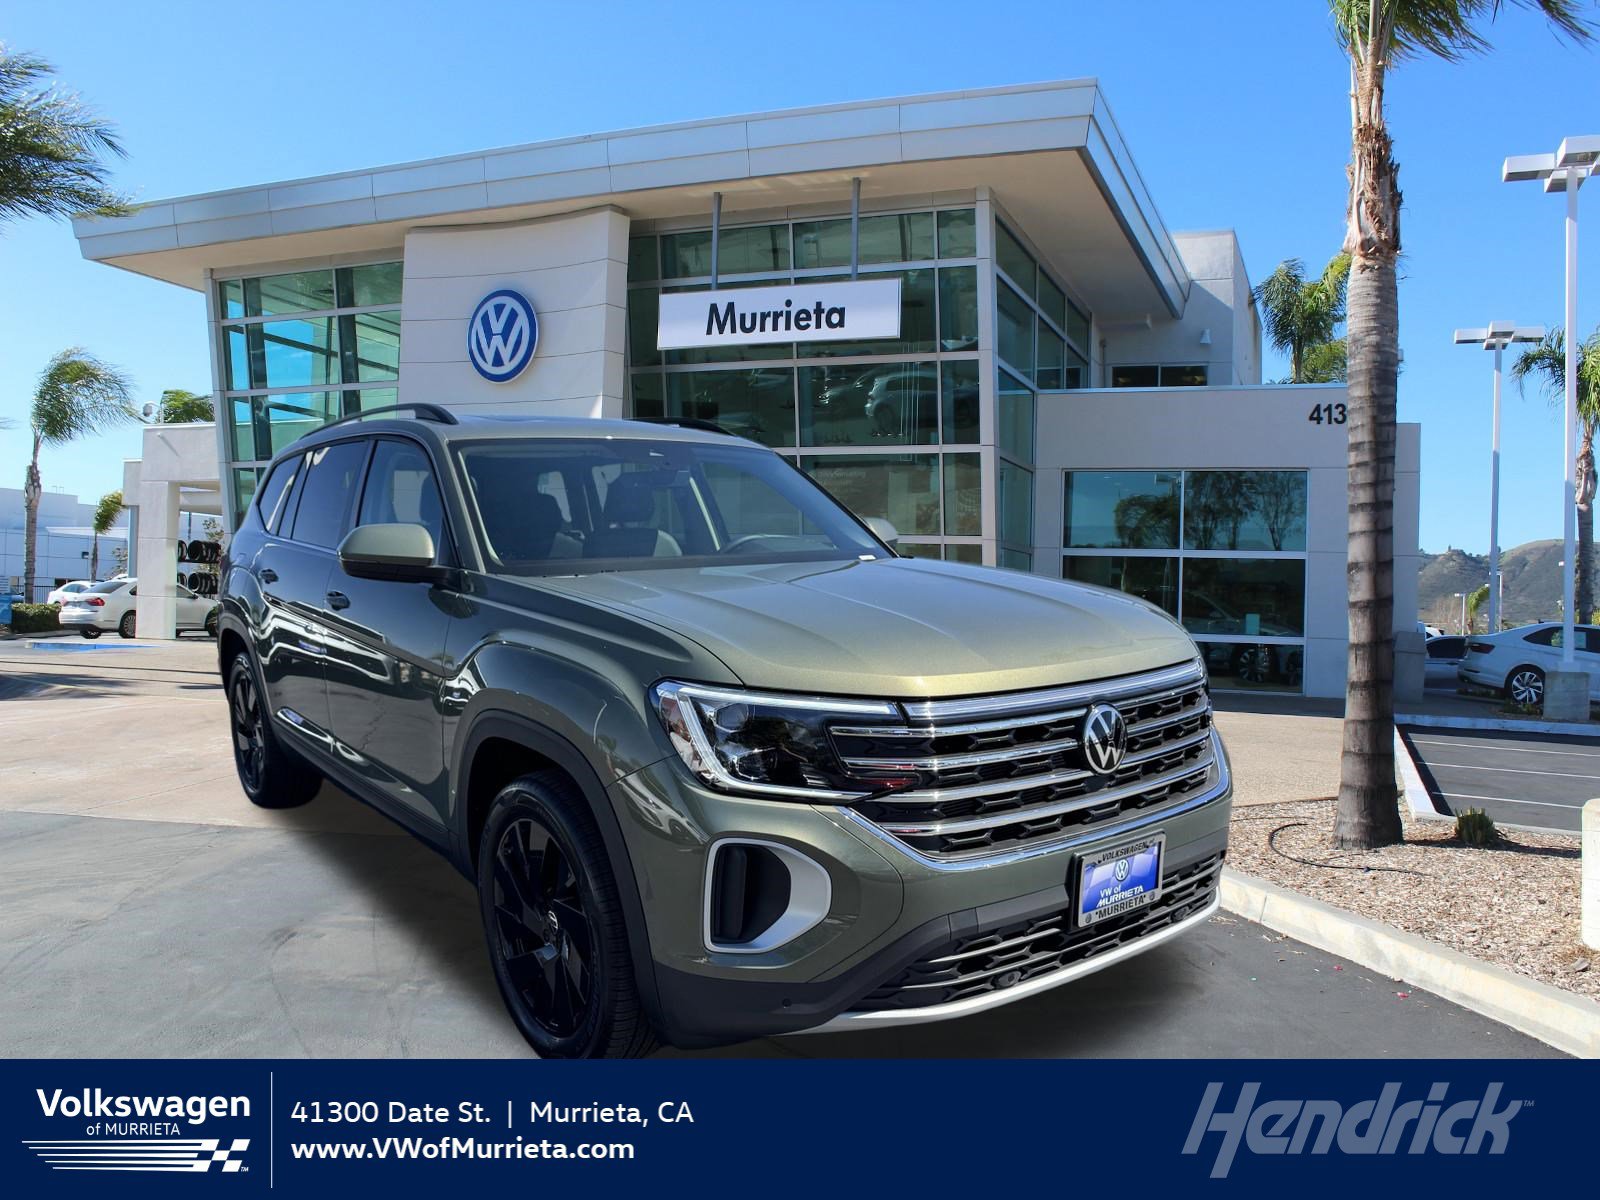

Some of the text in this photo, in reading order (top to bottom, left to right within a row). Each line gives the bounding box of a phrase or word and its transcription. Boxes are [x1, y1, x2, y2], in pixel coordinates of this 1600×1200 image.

[705, 299, 846, 336] Murrieta
[1308, 403, 1347, 425] 413
[1101, 841, 1148, 863] VOLKSWAGEN
[1095, 884, 1144, 909] MURRIETA
[1100, 885, 1121, 898] VW of
